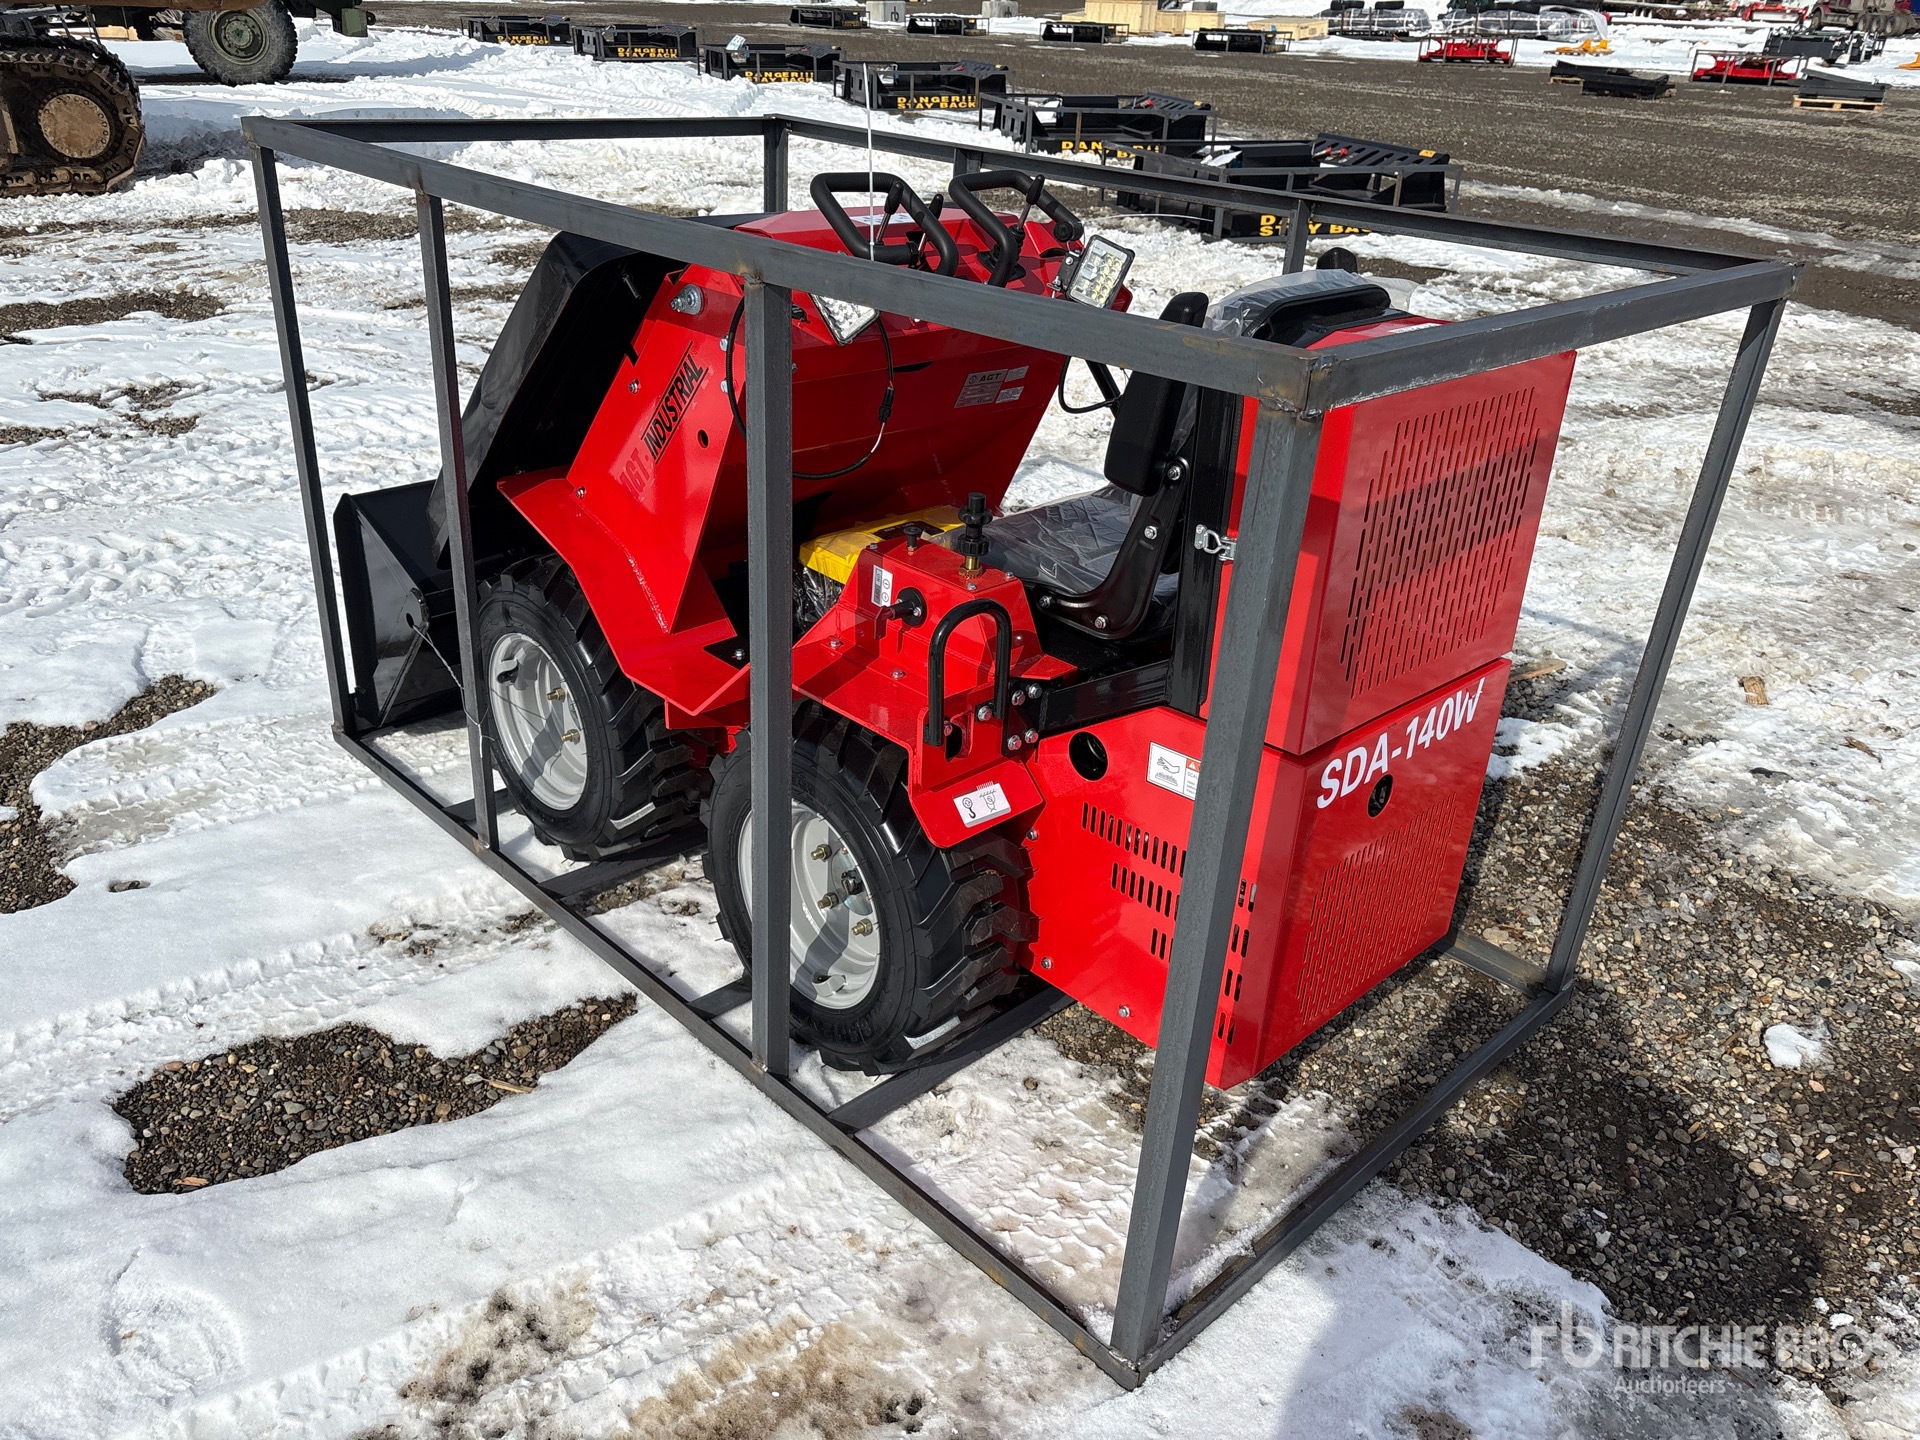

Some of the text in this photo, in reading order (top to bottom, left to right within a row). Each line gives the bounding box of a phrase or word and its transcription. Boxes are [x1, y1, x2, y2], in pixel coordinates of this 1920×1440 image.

[939, 101, 976, 109] BACK
[643, 353, 704, 461] INDUSTRIAL
[979, 372, 1002, 383] AGT
[1316, 676, 1486, 809] SDA-140W
